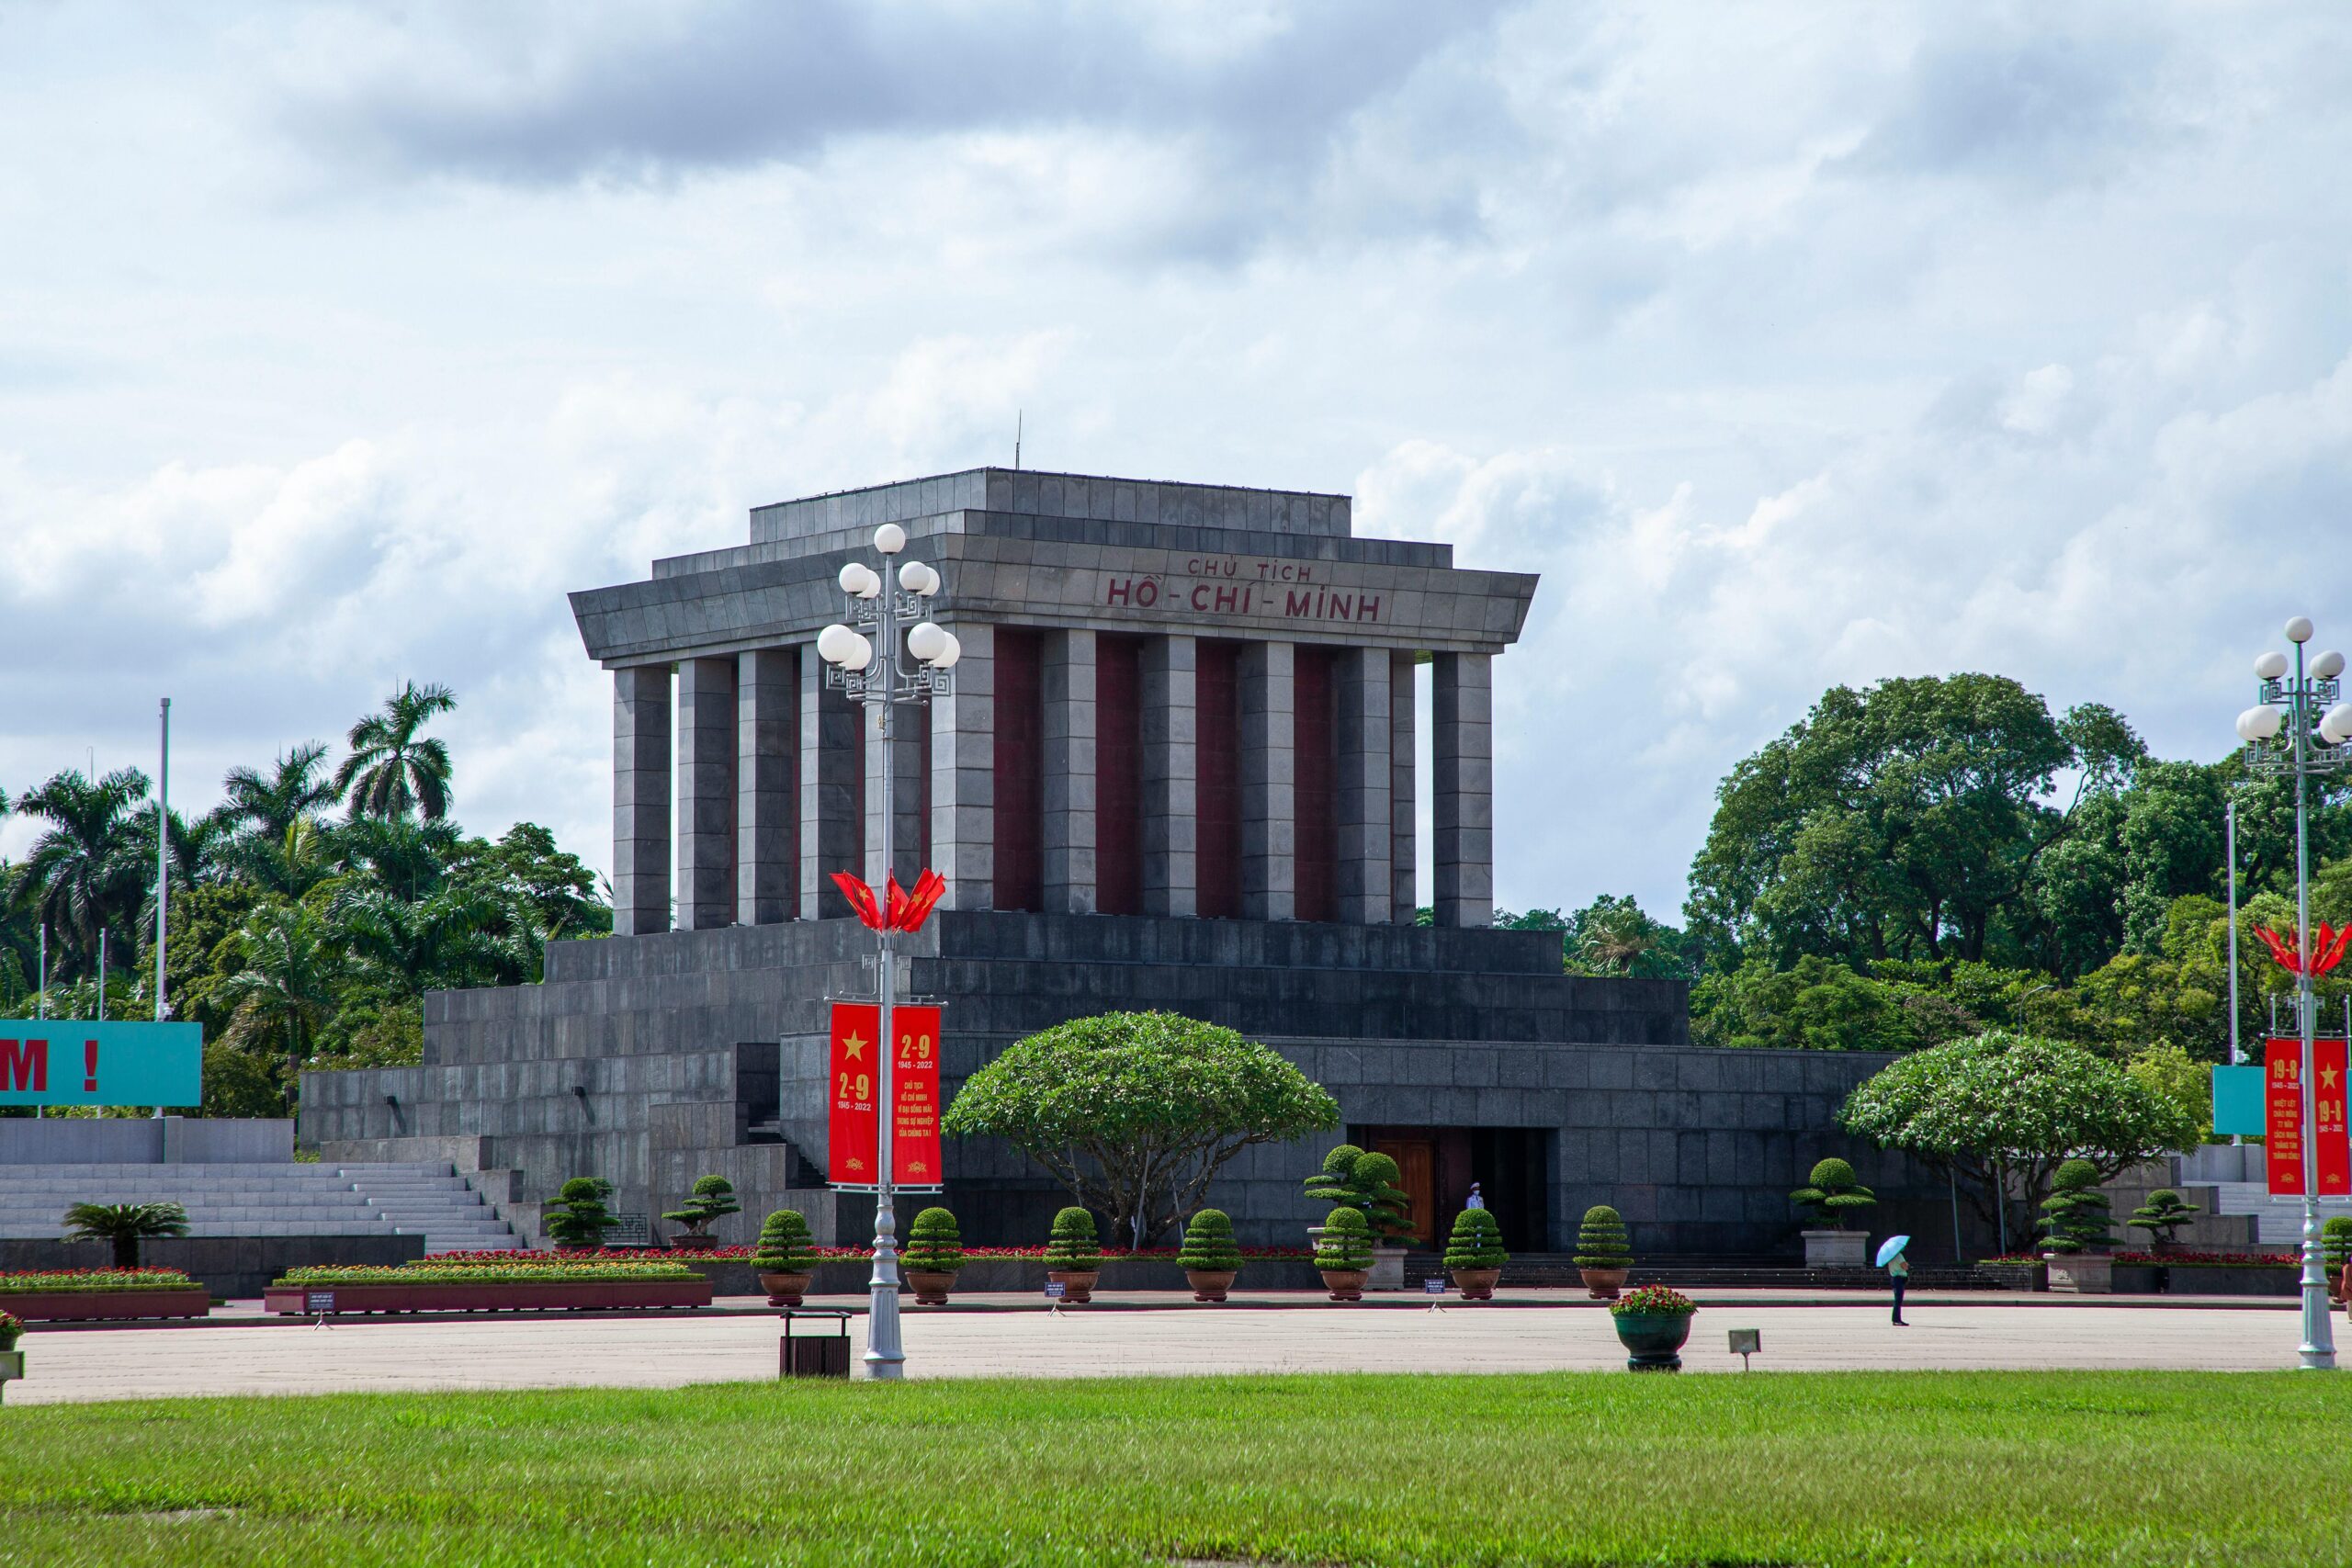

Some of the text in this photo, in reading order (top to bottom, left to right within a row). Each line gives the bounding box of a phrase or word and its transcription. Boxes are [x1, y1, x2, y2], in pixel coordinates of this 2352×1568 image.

[1188, 555, 1238, 577] CHỦ
[900, 1034, 930, 1059] 2-9
[898, 1060, 911, 1069] 1945
[916, 1060, 933, 1069] 2022
[2273, 1059, 2297, 1079] 19-8
[840, 1072, 869, 1100] 2-9
[838, 1100, 850, 1110] 1945
[854, 1102, 871, 1111] 2022
